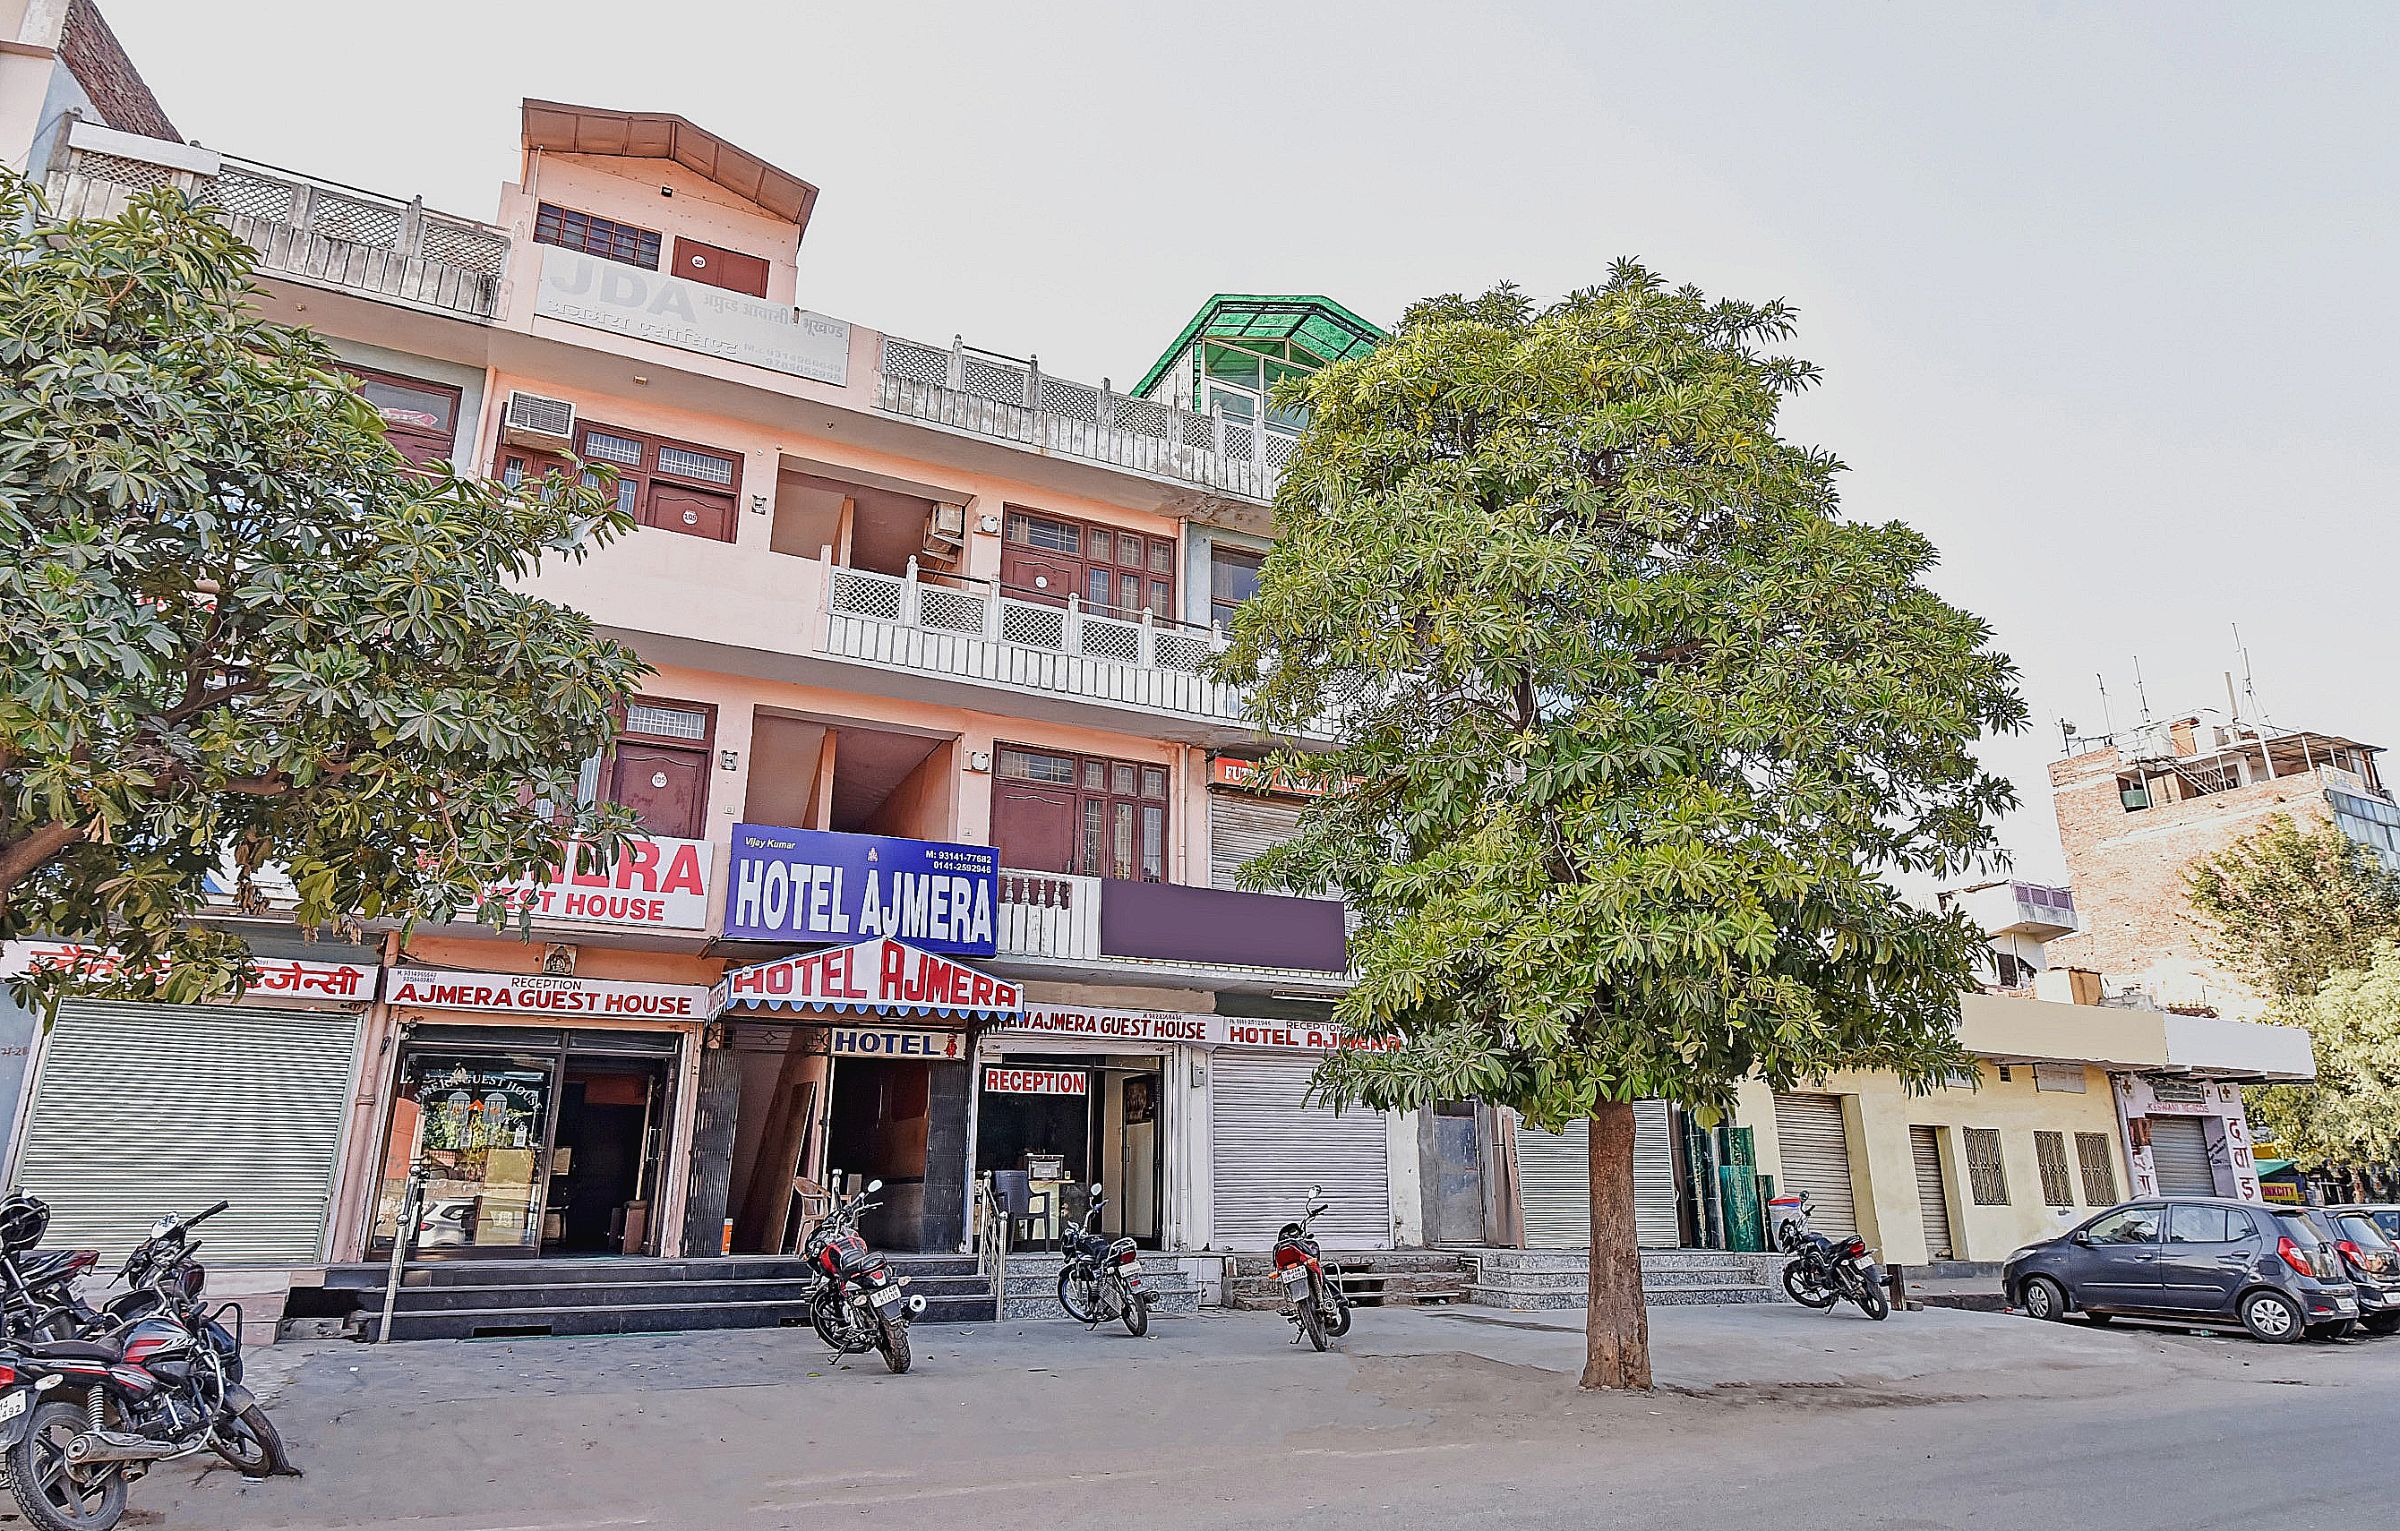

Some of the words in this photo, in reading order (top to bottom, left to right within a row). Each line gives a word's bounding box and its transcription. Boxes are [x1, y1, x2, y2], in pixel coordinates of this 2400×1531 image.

[549, 257, 697, 323] JDA
[745, 836, 766, 849] Vijay
[766, 838, 797, 850] Kumar
[925, 850, 937, 859] M:
[938, 851, 992, 864] 93141-77682
[565, 892, 665, 922] HOUSE
[735, 859, 850, 934] HOTEL
[858, 868, 993, 944] AJMERA
[511, 976, 582, 990] RECEPTION
[734, 950, 868, 1000] HOTEL
[879, 939, 1018, 1008] AJMERA
[394, 982, 513, 1006] AJMERA
[517, 989, 602, 1011] GUEST
[605, 994, 692, 1016] HOUSE
[1034, 1011, 1097, 1037] AJMERA
[1100, 1015, 1150, 1038] GUEST
[1154, 1019, 1206, 1041] HOUSE
[1230, 1026, 1299, 1047] HOTEL
[1286, 1021, 1344, 1033] RECEPTION
[834, 1031, 941, 1057] HOTEL
[986, 1069, 1086, 1094] RECEPTION
